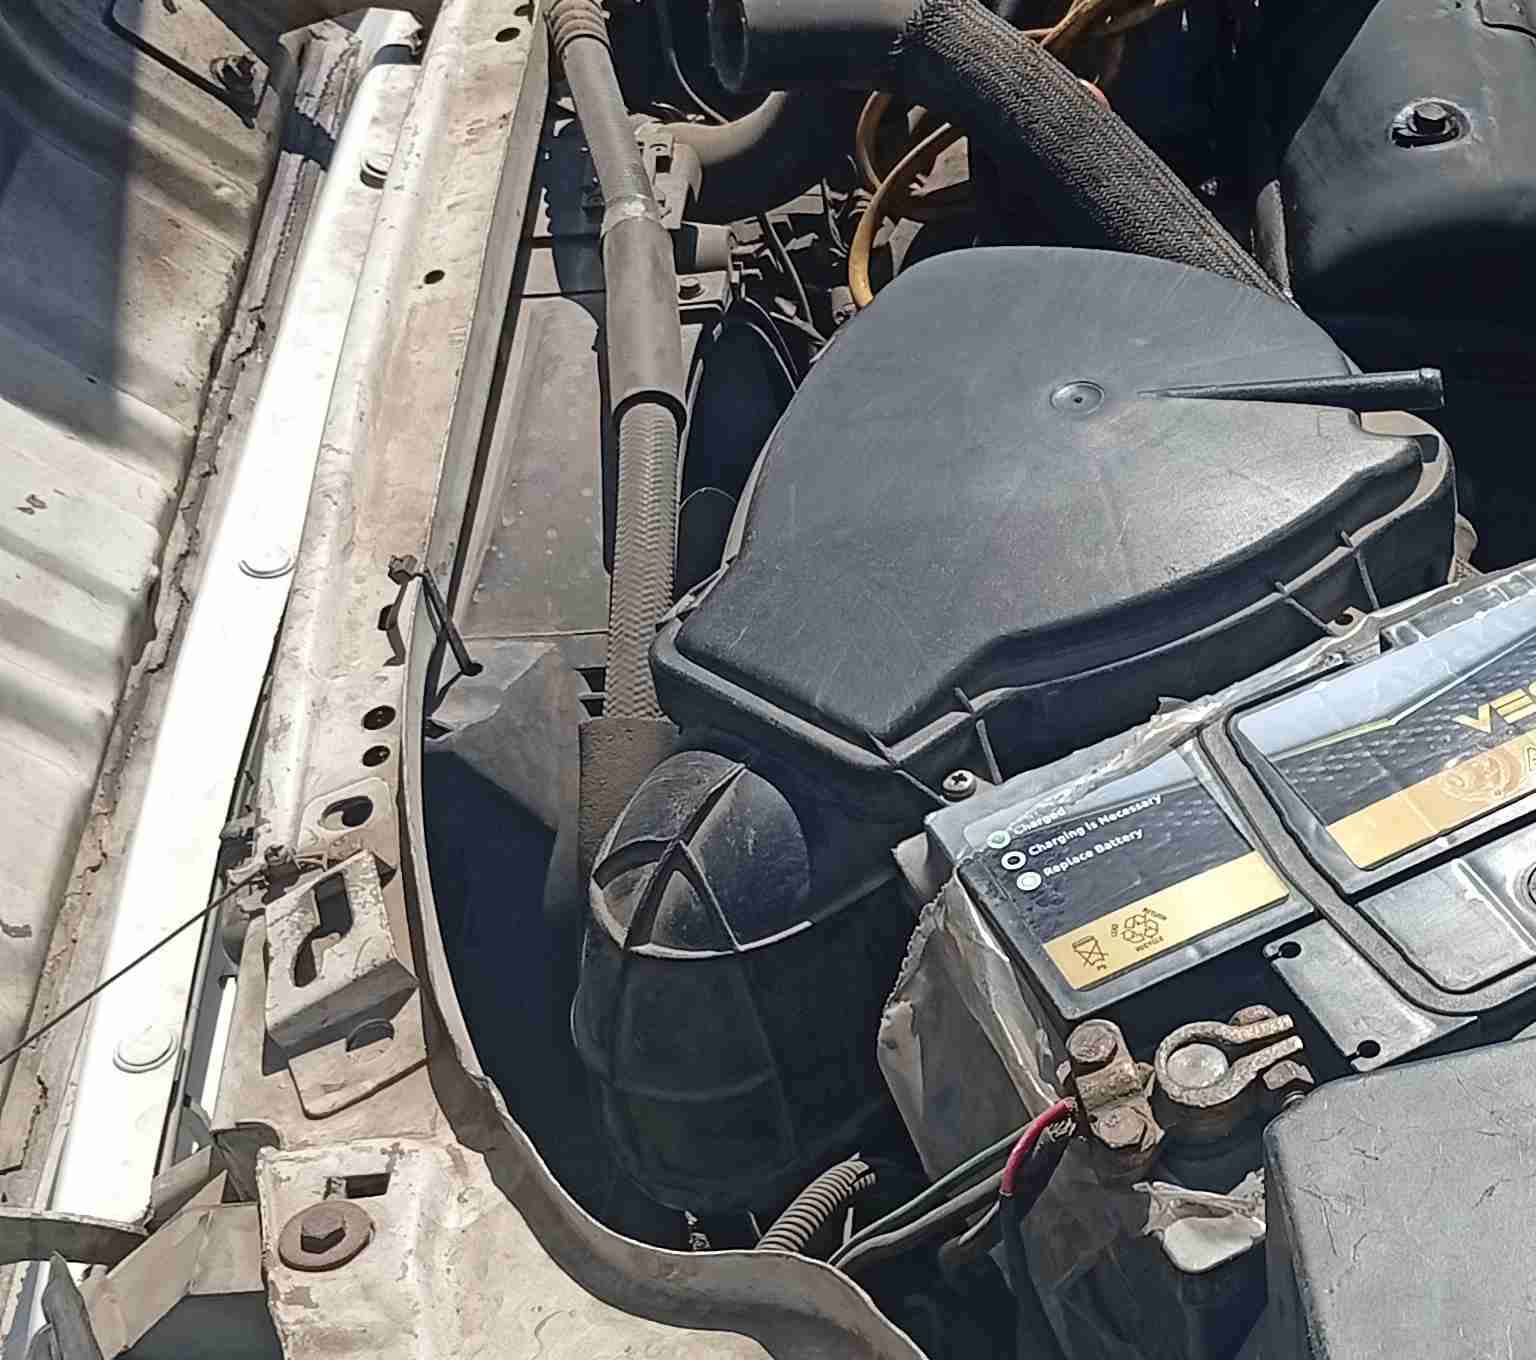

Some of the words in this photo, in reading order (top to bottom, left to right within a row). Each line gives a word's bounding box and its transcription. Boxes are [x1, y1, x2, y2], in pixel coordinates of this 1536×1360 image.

[1013, 807, 1067, 835] Charged
[1028, 826, 1086, 856] Charging
[1097, 793, 1162, 826] Necessary
[1043, 850, 1094, 877] Replace
[1093, 828, 1144, 853] Battery
